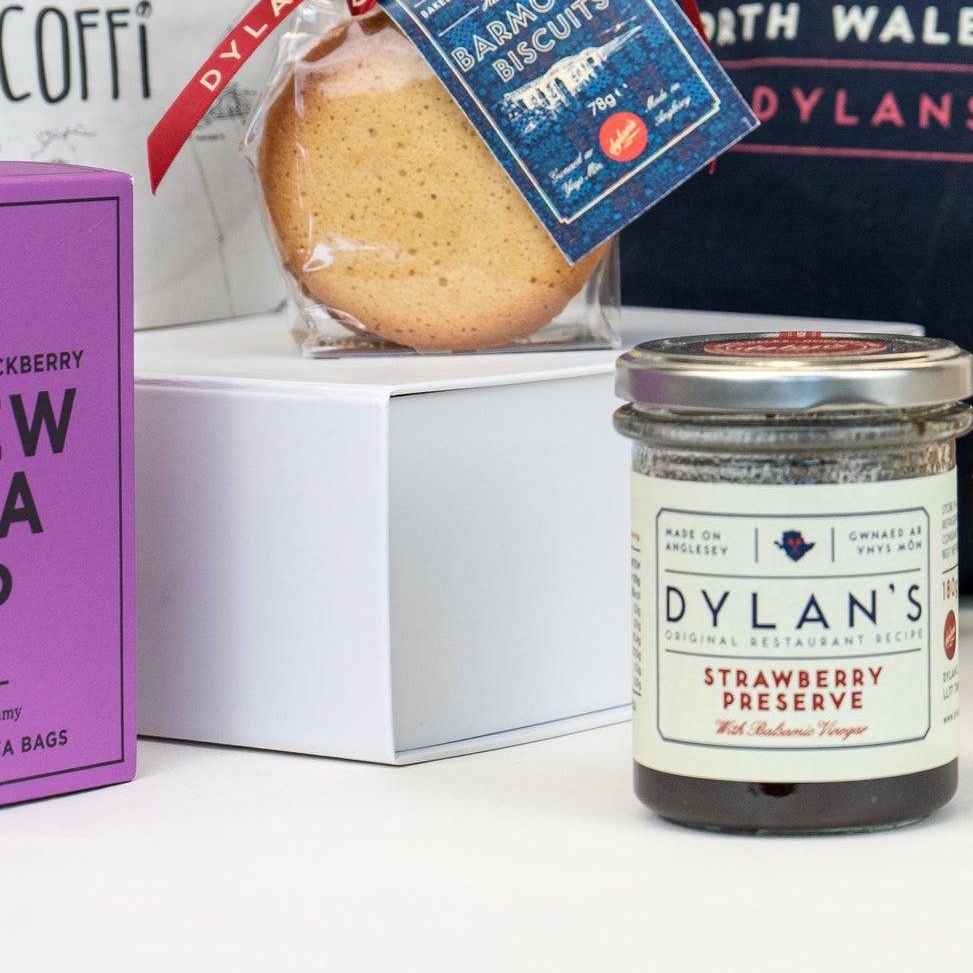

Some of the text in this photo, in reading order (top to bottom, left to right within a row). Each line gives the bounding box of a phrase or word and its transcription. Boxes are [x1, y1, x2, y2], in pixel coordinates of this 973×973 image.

[665, 528, 721, 541] MADE ON
[848, 525, 923, 542] GWNAED AR
[665, 542, 729, 557] ANGLESEY
[857, 541, 892, 555] YNYS
[665, 582, 923, 630] DYLAN'S
[664, 628, 924, 648] ORIGINAL RESTAURANT RECIPE
[704, 665, 884, 689] STRAWBERRY
[722, 691, 863, 712] PRESERVE
[714, 718, 869, 741] With Balsamic Vinegar
[21, 729, 68, 754] BAGS
